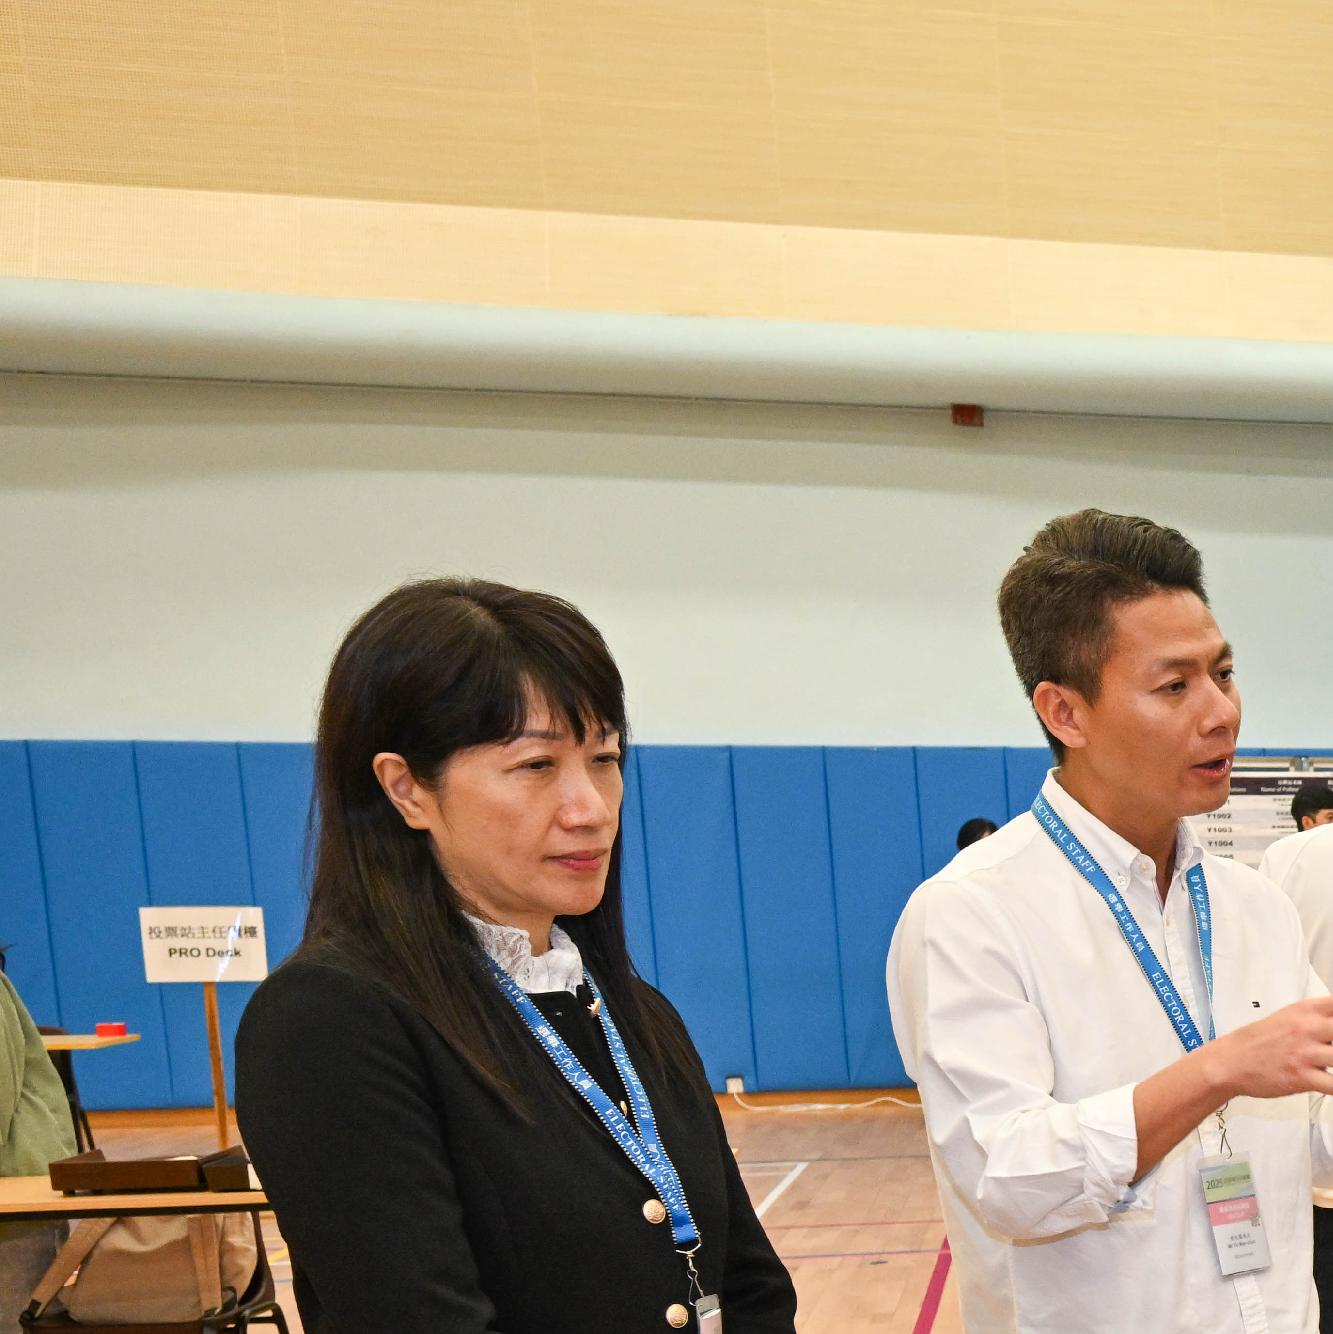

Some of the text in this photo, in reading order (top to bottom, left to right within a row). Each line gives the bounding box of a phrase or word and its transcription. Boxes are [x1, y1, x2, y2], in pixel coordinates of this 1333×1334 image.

[1034, 798, 1096, 874] ECTORAL STAFF
[168, 948, 241, 958] PRO Desk
[1152, 972, 1191, 1038] ELECTORAL
[605, 1109, 680, 1211] ELECTORAL STAFF
[1206, 1179, 1224, 1190] 2025
